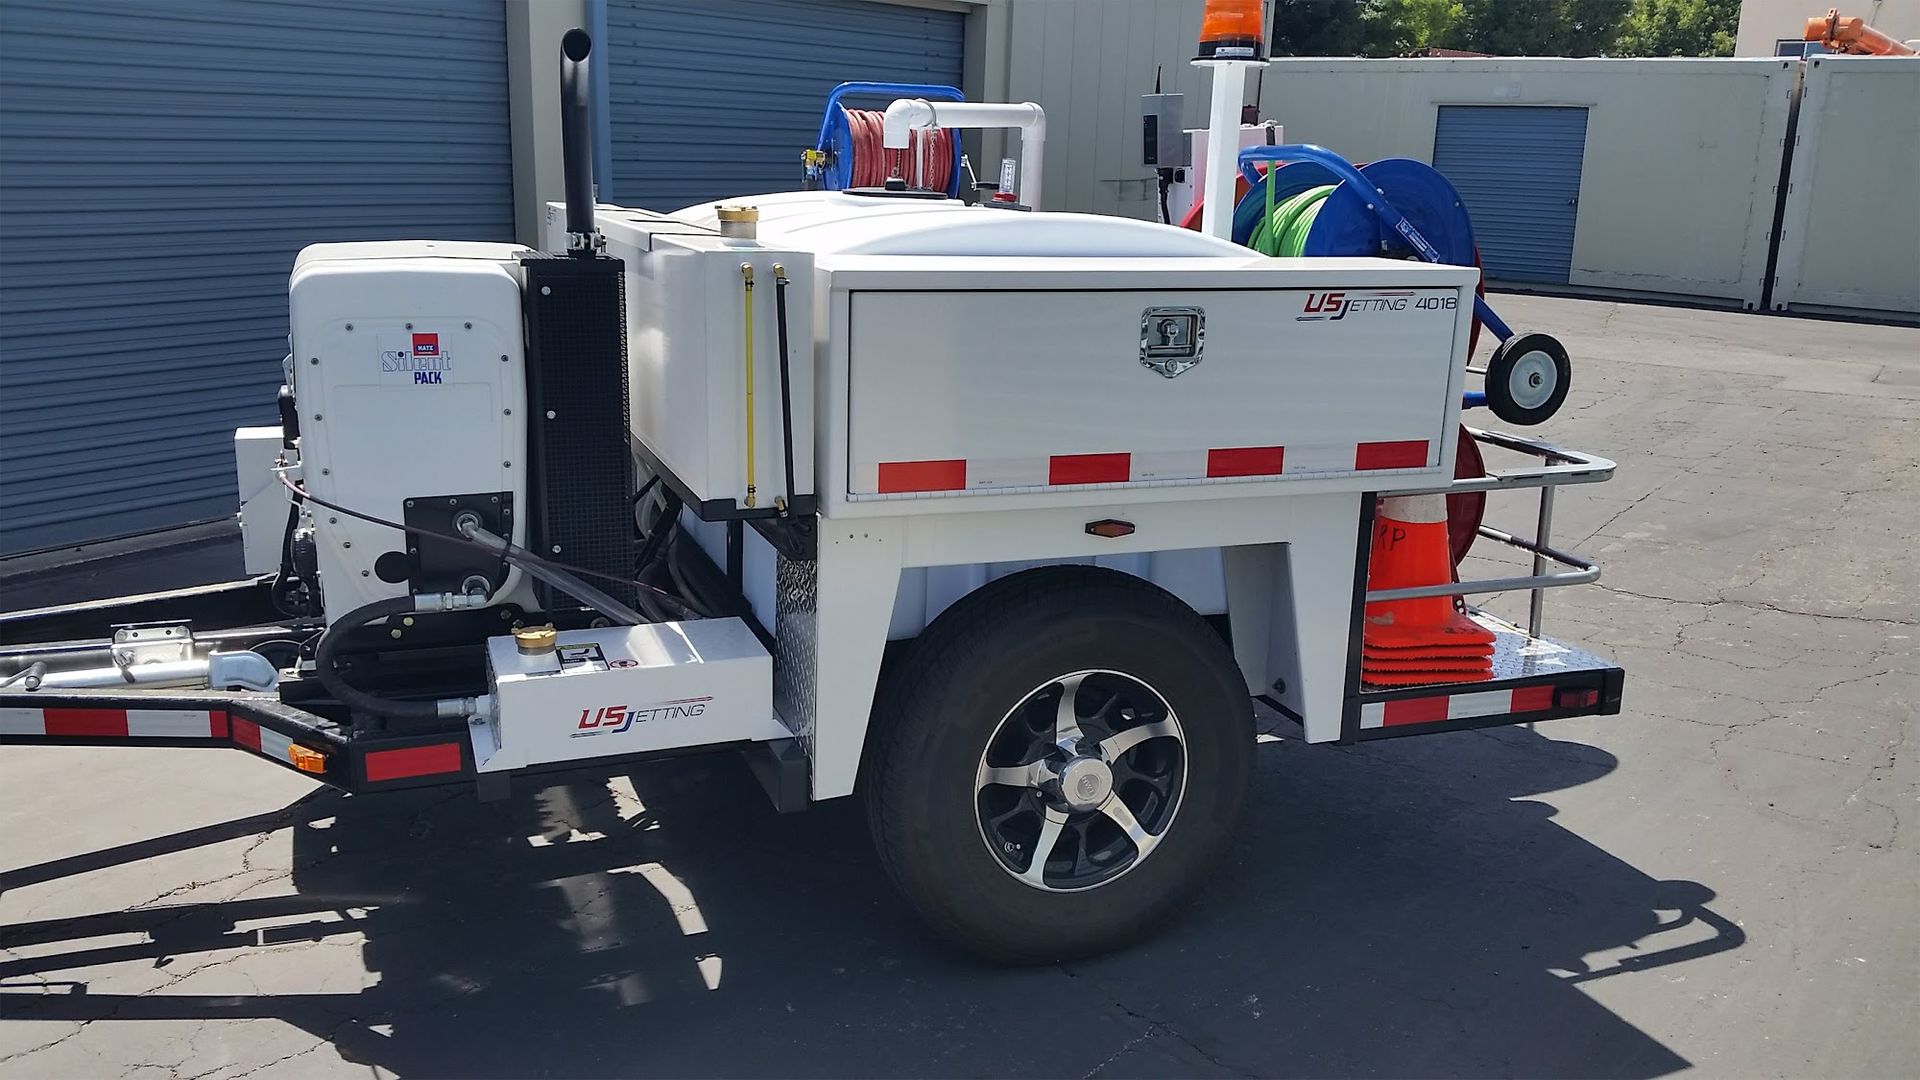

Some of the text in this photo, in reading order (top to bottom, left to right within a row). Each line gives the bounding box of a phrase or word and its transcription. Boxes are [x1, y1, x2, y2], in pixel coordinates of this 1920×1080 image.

[1415, 297, 1457, 310] 4018
[381, 350, 452, 372] Silent
[414, 371, 442, 384] PACK
